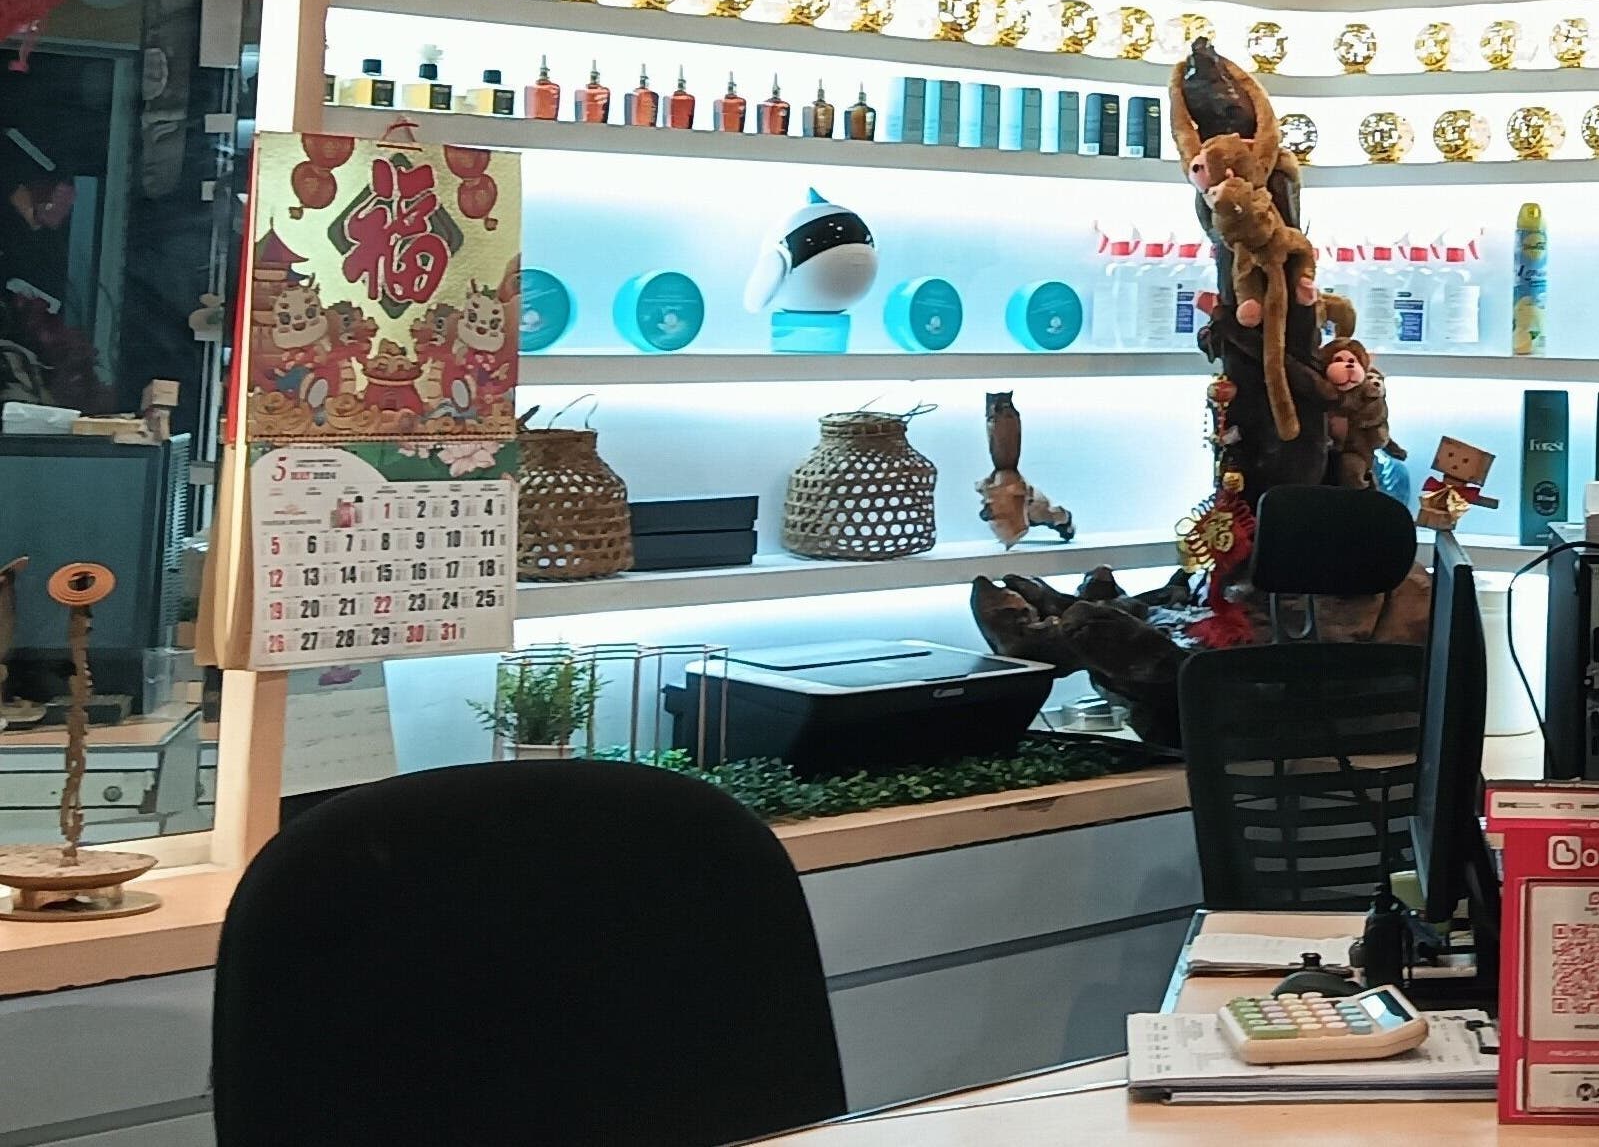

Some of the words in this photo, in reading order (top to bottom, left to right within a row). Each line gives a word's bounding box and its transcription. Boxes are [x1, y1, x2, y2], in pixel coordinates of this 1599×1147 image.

[272, 456, 287, 482] 5
[384, 502, 391, 519] 1
[416, 500, 427, 519] 2
[451, 500, 460, 518] 3
[484, 498, 493, 516] 4
[271, 536, 281, 555] 5
[307, 535, 317, 553] 6
[346, 534, 354, 552] 7
[381, 532, 390, 551] 8
[416, 531, 425, 550] 9
[446, 530, 461, 547] 10
[481, 529, 495, 547] 11
[268, 569, 283, 588] 12
[302, 567, 320, 586] 13
[340, 565, 357, 584] 14
[376, 563, 392, 583] 15
[411, 562, 427, 580] 16
[446, 560, 460, 578] 17
[478, 559, 495, 577] 18
[301, 600, 320, 619] 20
[338, 598, 356, 616] 21
[374, 595, 392, 614] 22
[408, 593, 426, 611] 23
[442, 591, 459, 609] 24
[475, 590, 496, 608] 25
[301, 632, 318, 651] 27
[336, 629, 355, 648] 28
[371, 627, 390, 646] 29
[406, 624, 425, 643] 30
[440, 622, 457, 641] 31
